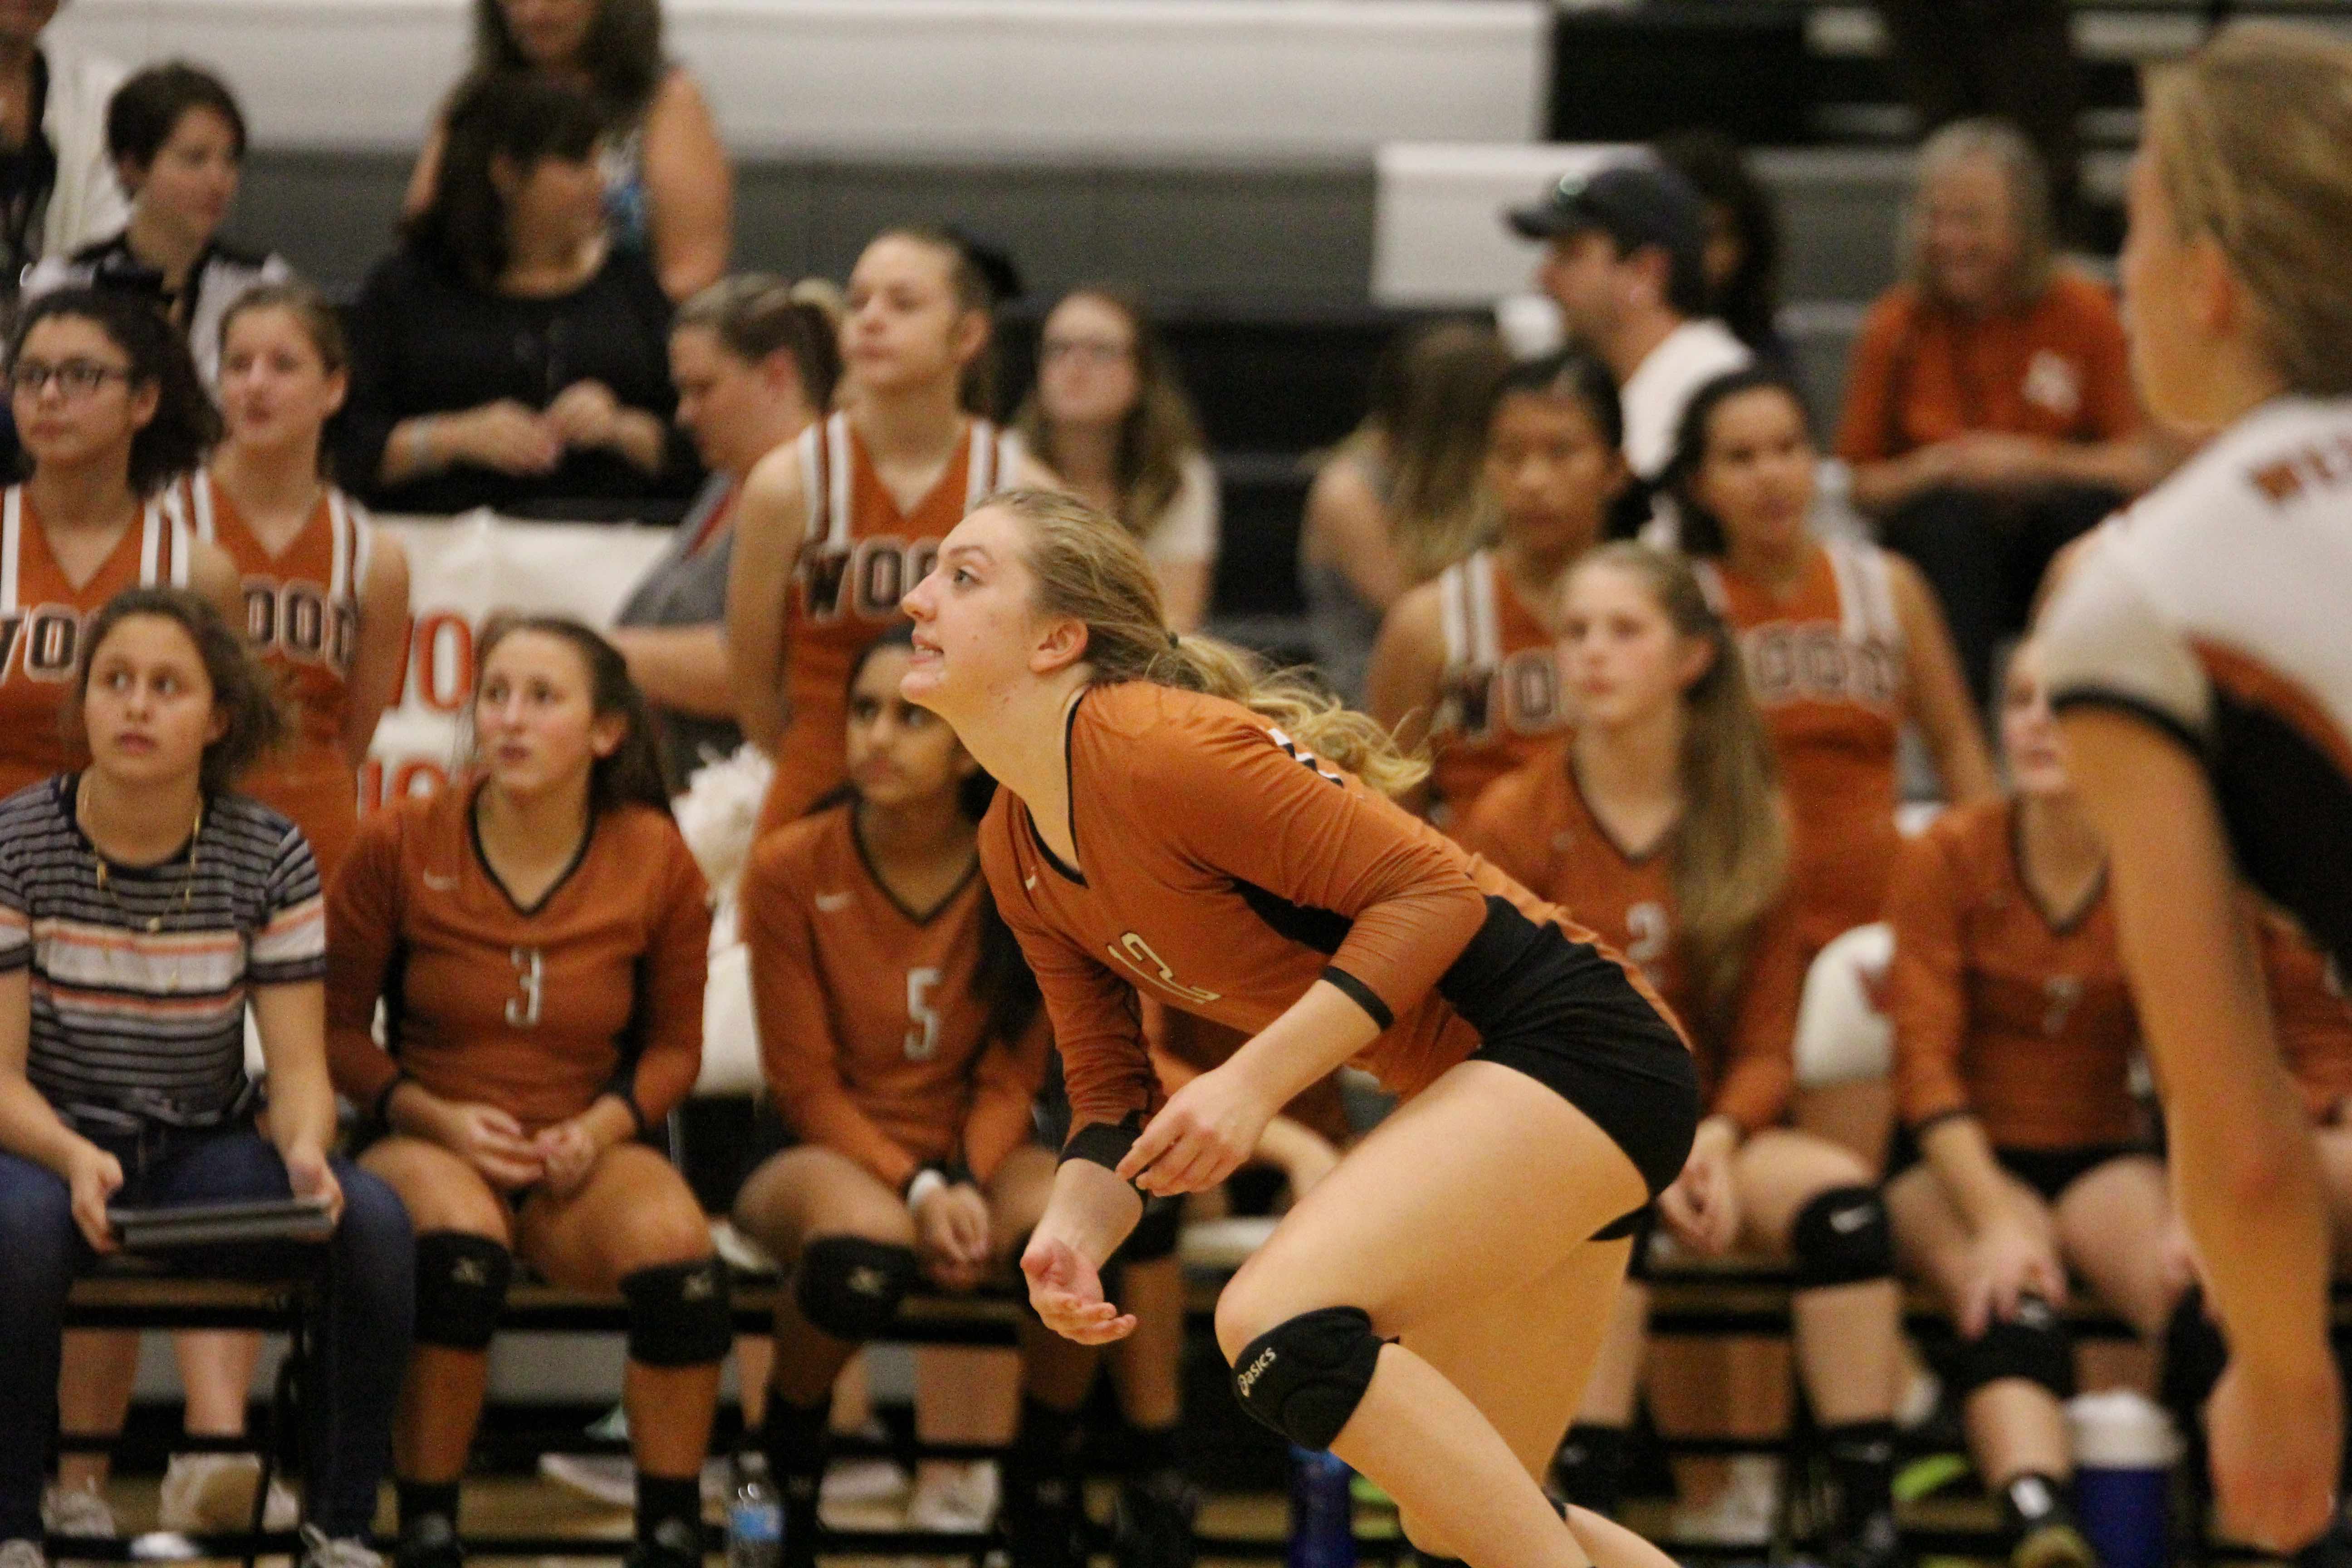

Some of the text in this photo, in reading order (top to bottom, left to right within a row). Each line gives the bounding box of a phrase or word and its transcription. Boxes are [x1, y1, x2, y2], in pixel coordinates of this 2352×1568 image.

[505, 946, 543, 1028] 3
[906, 968, 944, 1060] 5
[1243, 1347, 1277, 1387] asics
